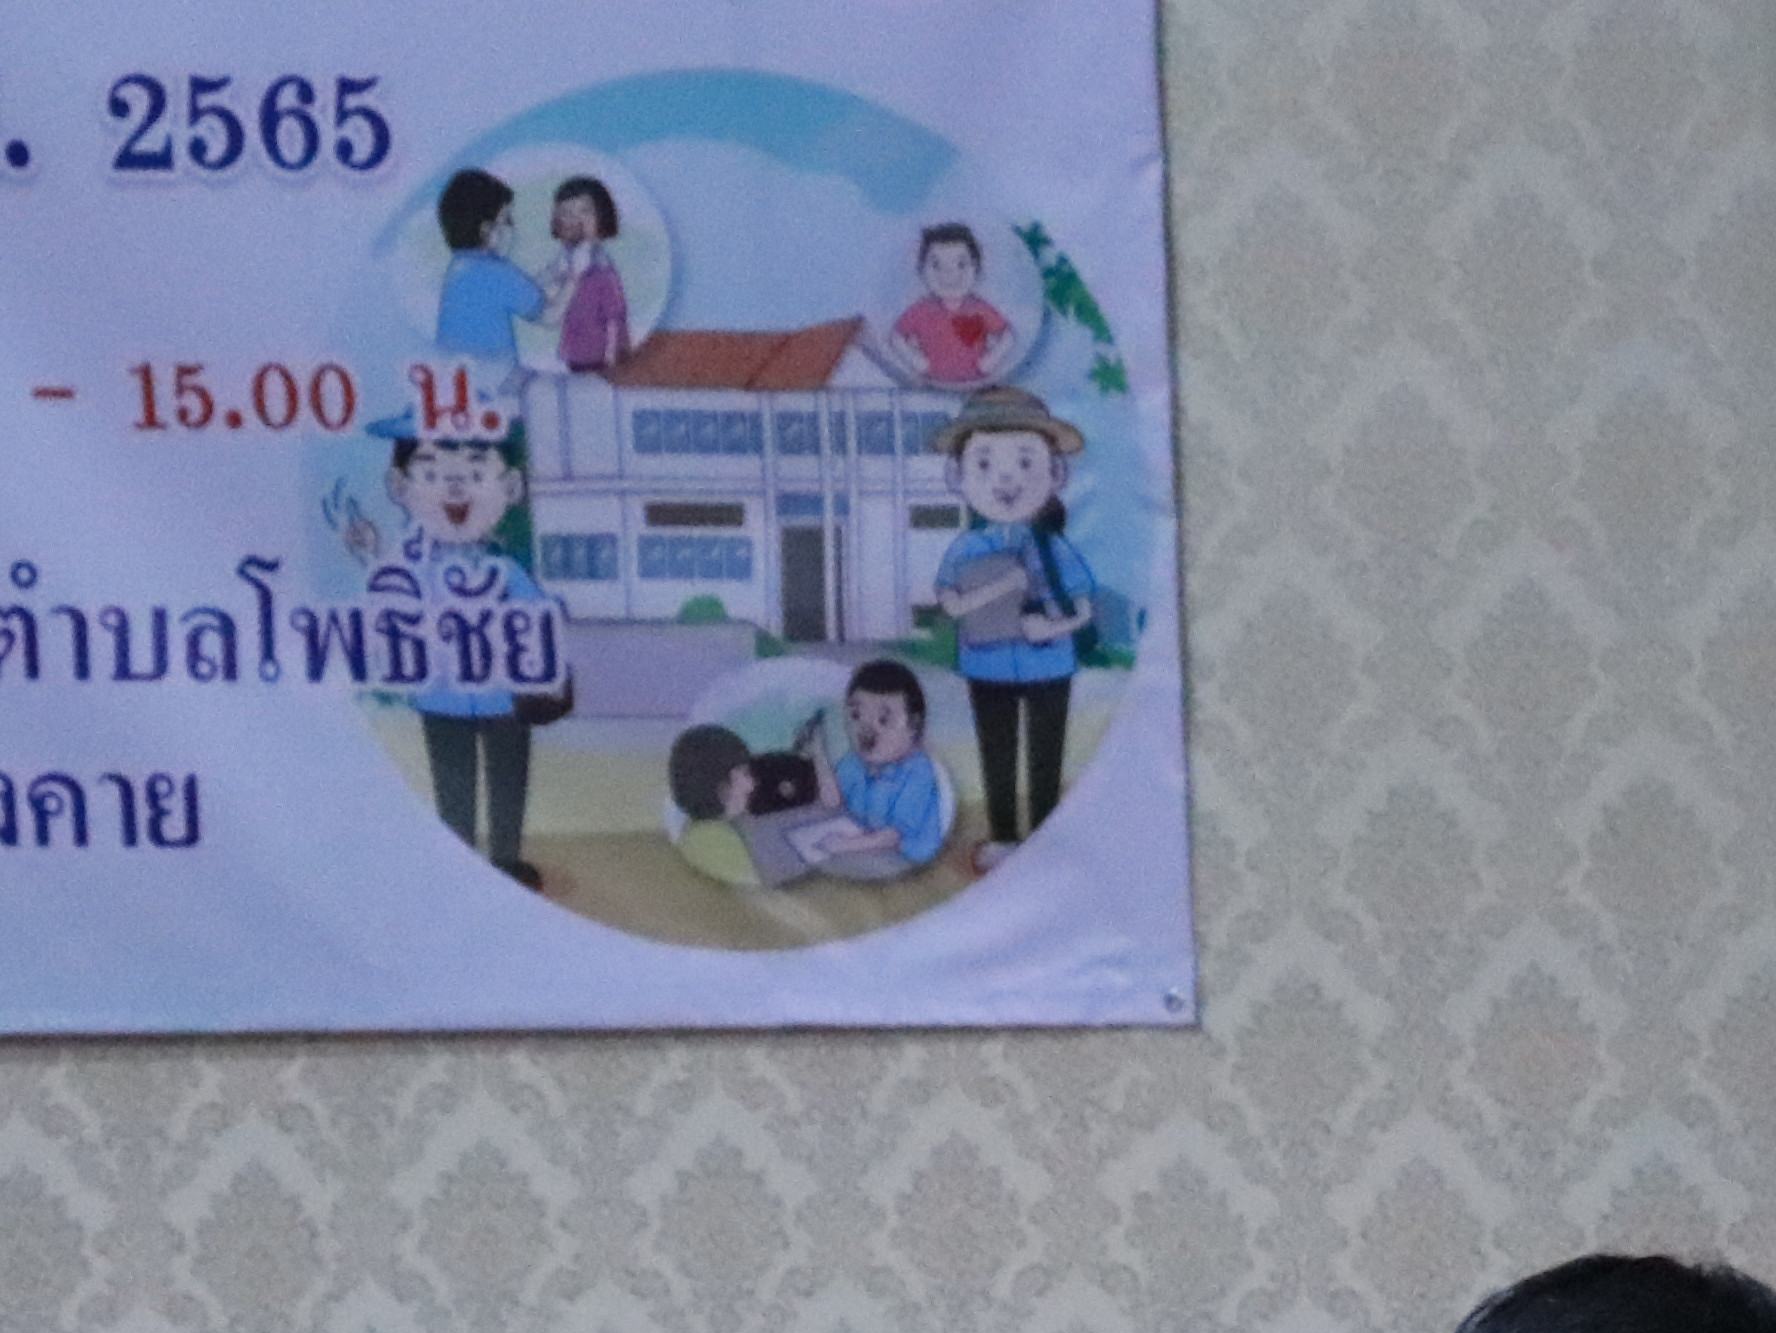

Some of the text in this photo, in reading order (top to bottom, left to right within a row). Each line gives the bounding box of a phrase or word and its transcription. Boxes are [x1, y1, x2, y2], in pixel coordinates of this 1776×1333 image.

[107, 73, 391, 171] 2565
[129, 361, 356, 430] 15.00
[408, 364, 500, 431] น.
